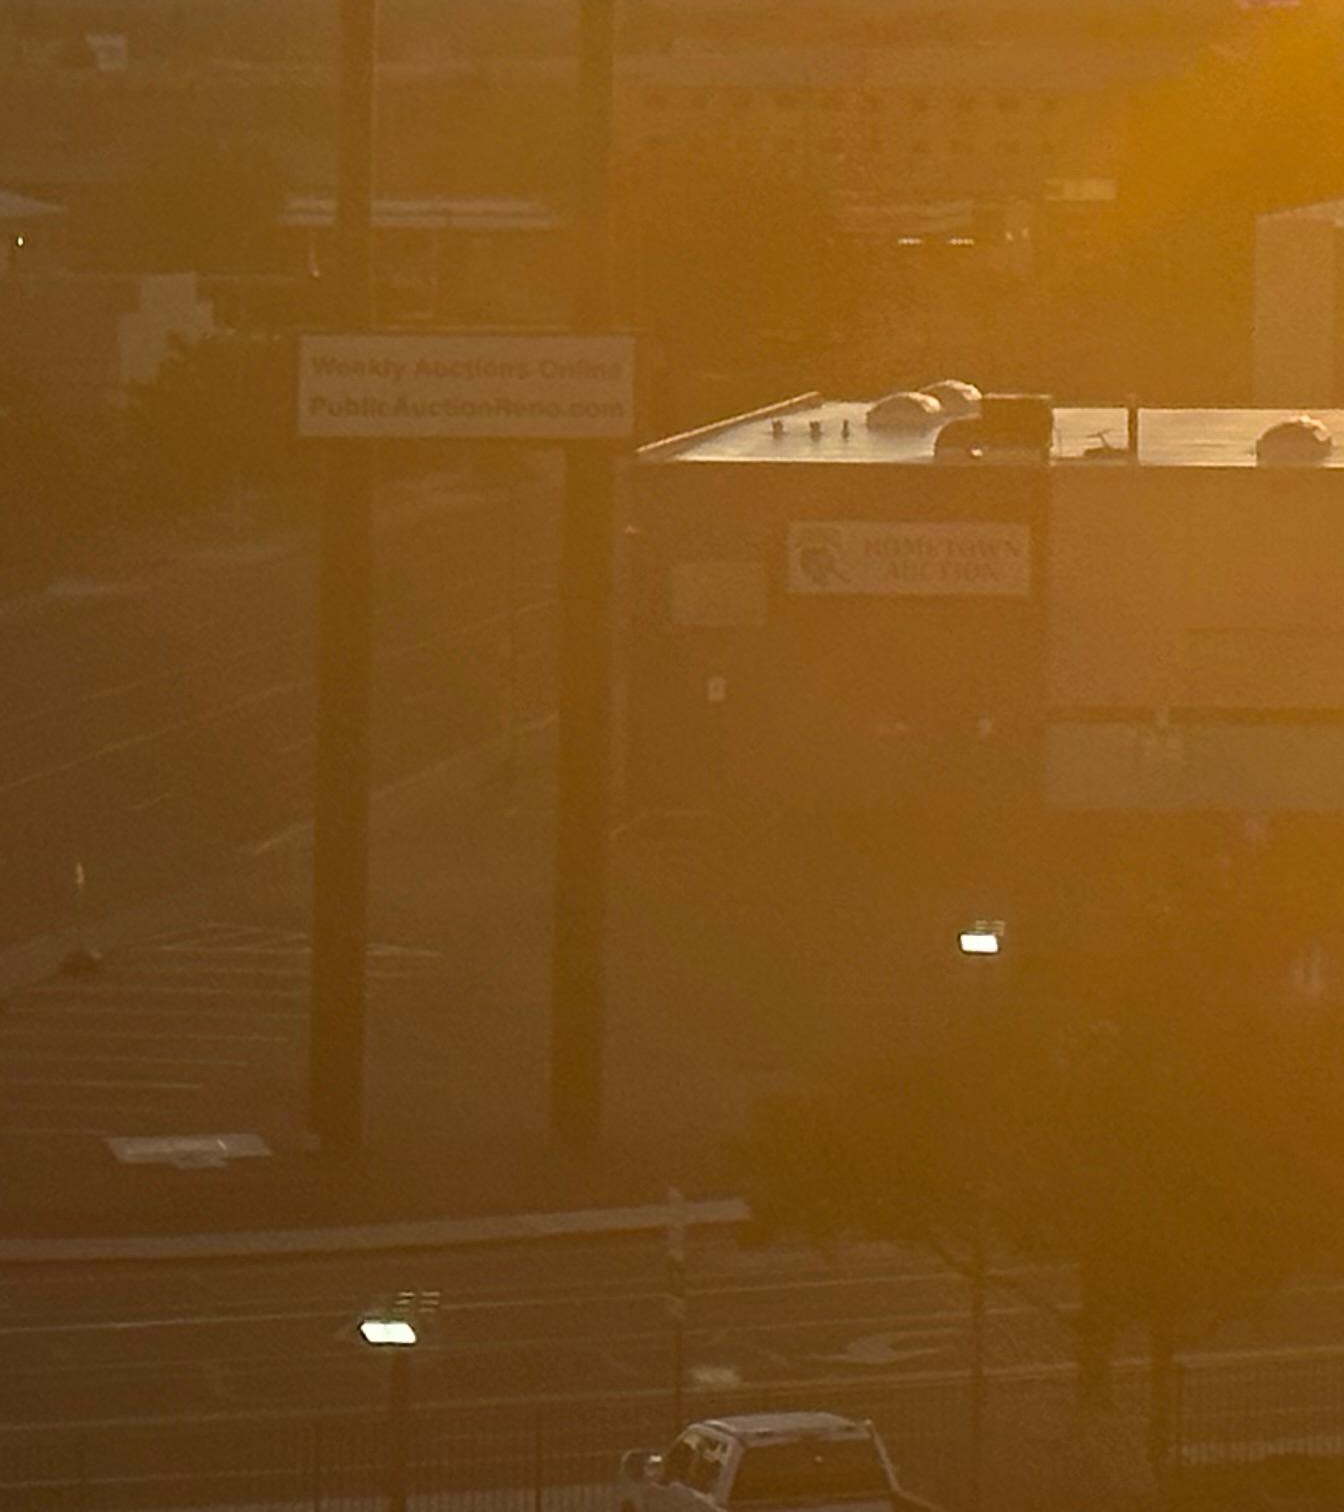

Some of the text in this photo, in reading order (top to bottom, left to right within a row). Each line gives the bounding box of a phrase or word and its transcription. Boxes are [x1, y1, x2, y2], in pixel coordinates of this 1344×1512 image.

[311, 356, 623, 383] Weekly Auctions Online
